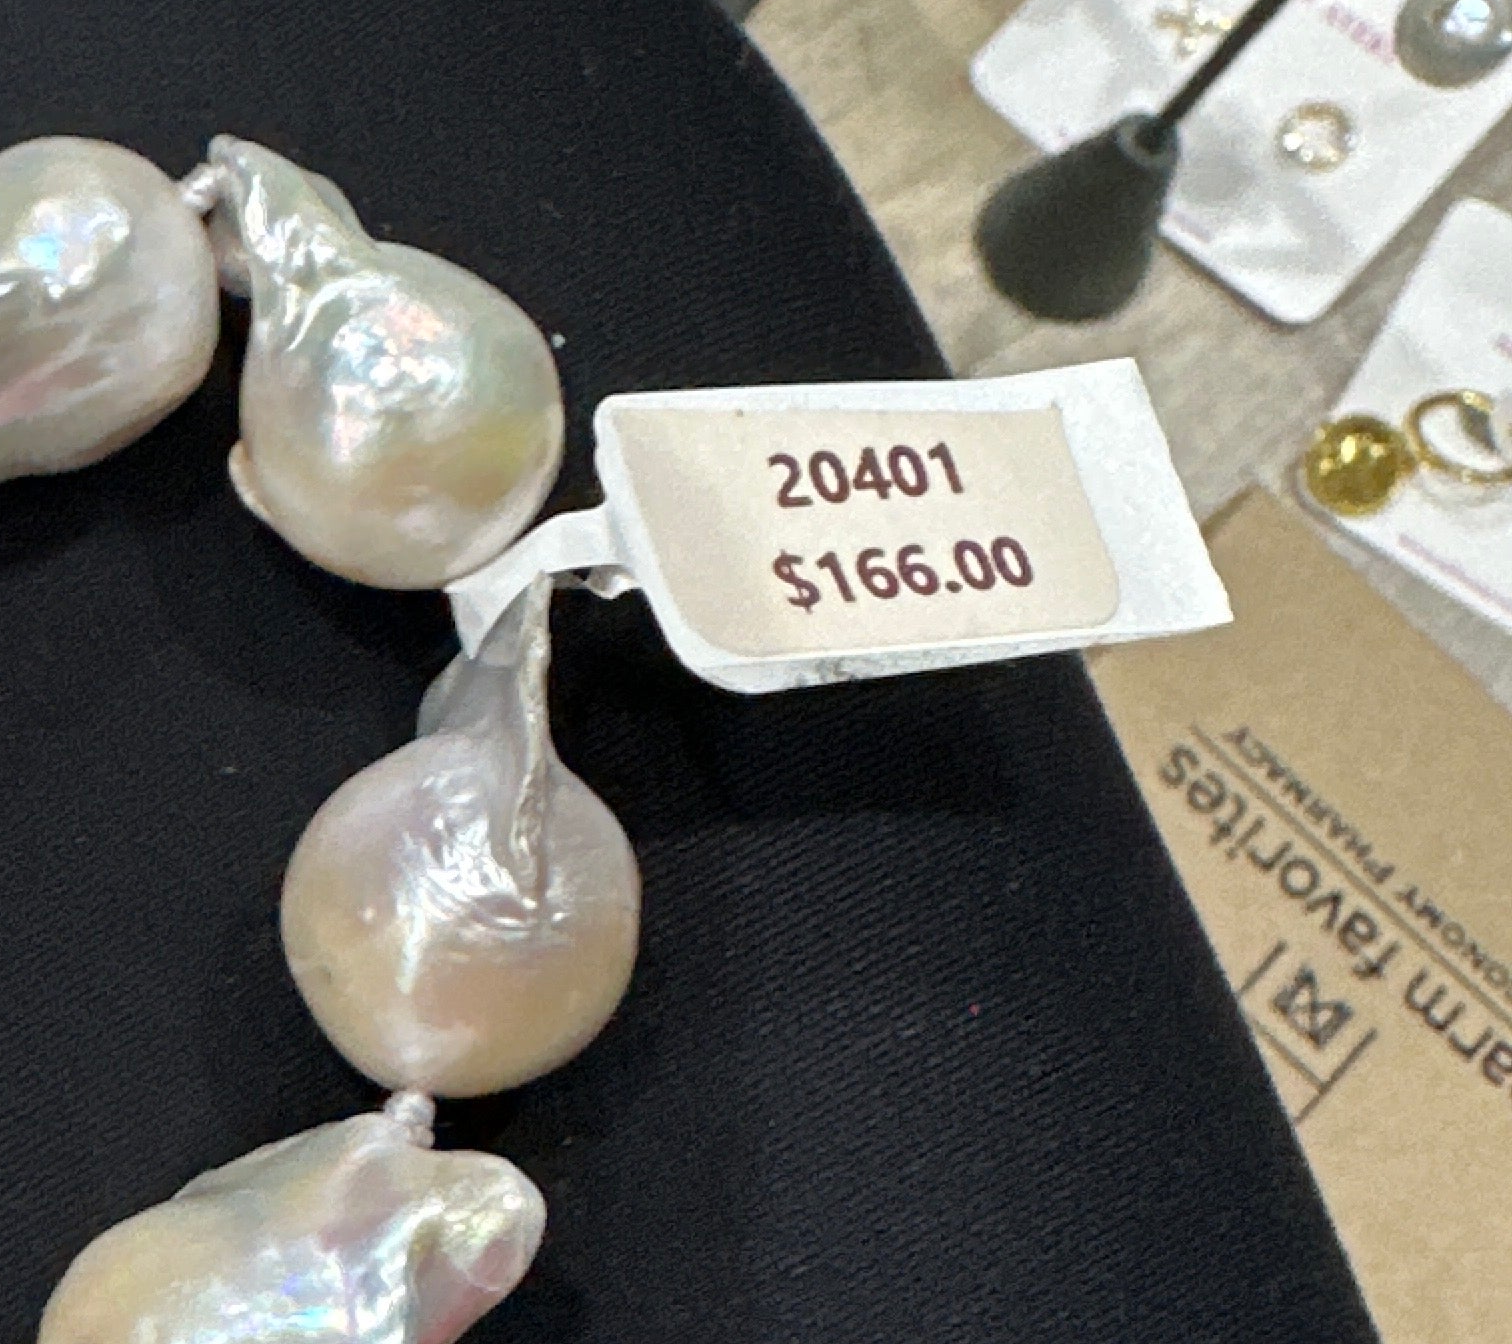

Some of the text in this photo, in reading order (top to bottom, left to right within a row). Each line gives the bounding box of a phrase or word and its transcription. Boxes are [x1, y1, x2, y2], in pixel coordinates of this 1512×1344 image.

[768, 441, 965, 508] 20401
[772, 535, 1034, 613] $166.00
[1159, 745, 1512, 1094] arm favorites
[1395, 884, 1512, 996] ONOMY
